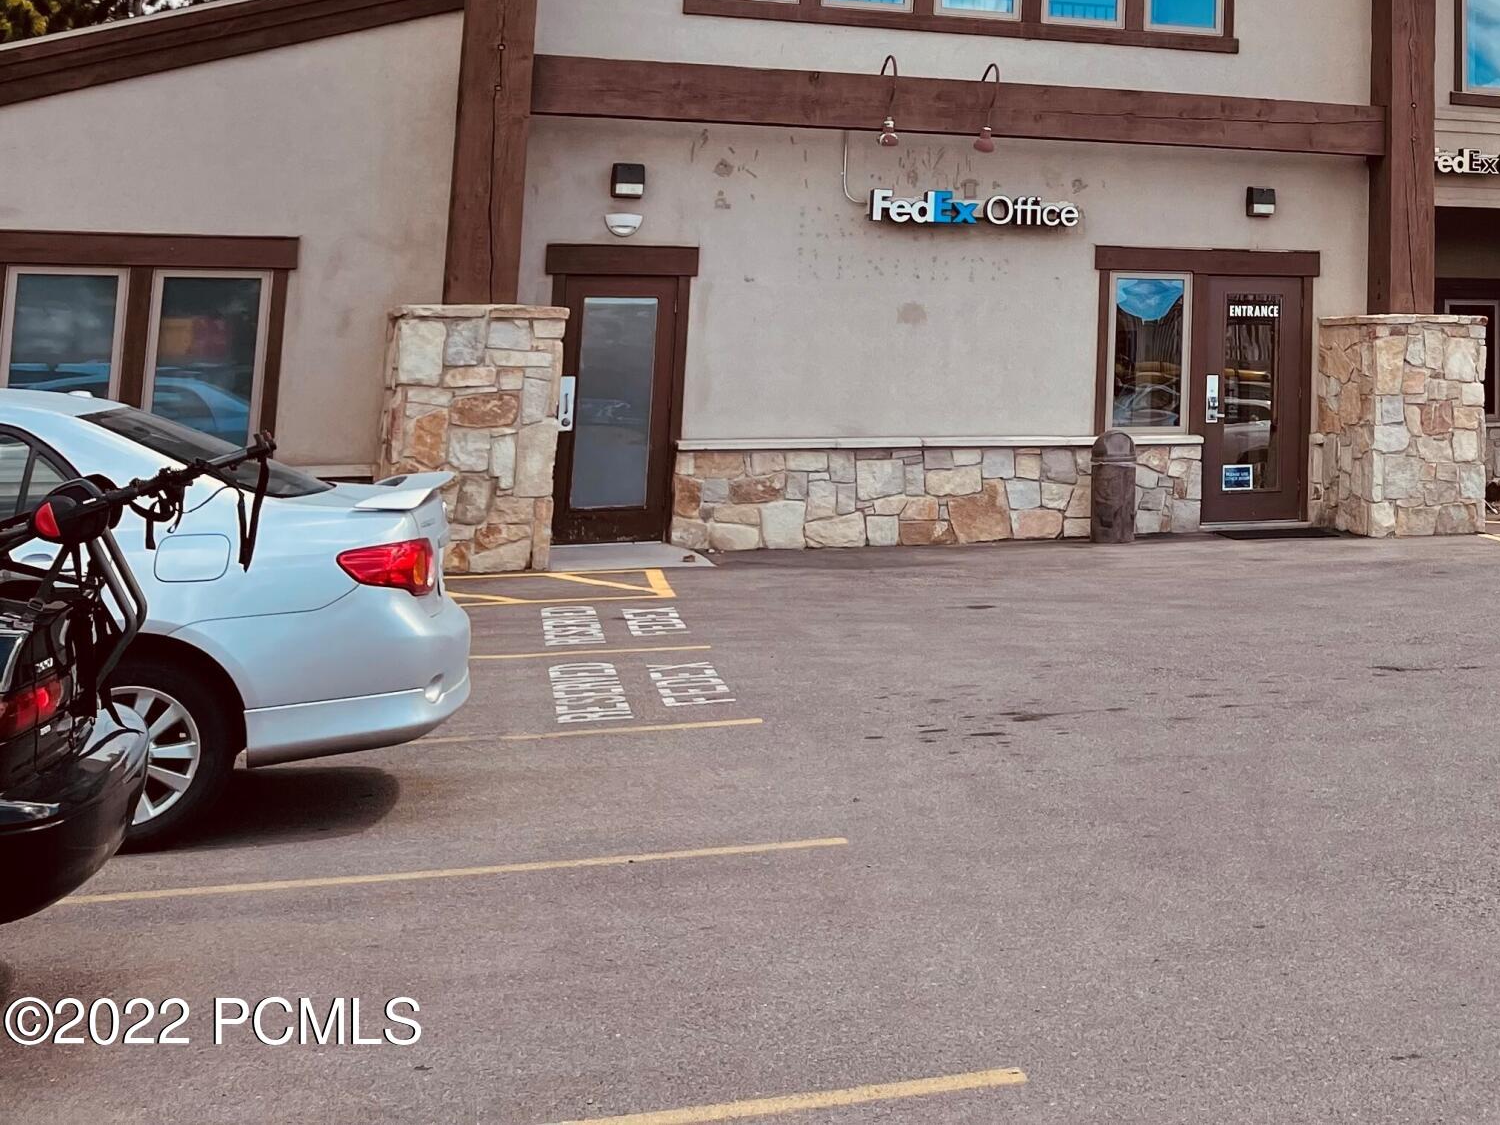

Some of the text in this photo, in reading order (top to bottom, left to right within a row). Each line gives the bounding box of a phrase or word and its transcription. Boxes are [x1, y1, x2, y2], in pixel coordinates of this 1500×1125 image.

[870, 189, 1079, 226] FedEx Office
[1229, 305, 1279, 317] ENTRANCE
[541, 606, 607, 646] RESERVED
[621, 607, 691, 637] FEDEX
[548, 662, 635, 724] RESERVED
[646, 662, 737, 707] FEDEX
